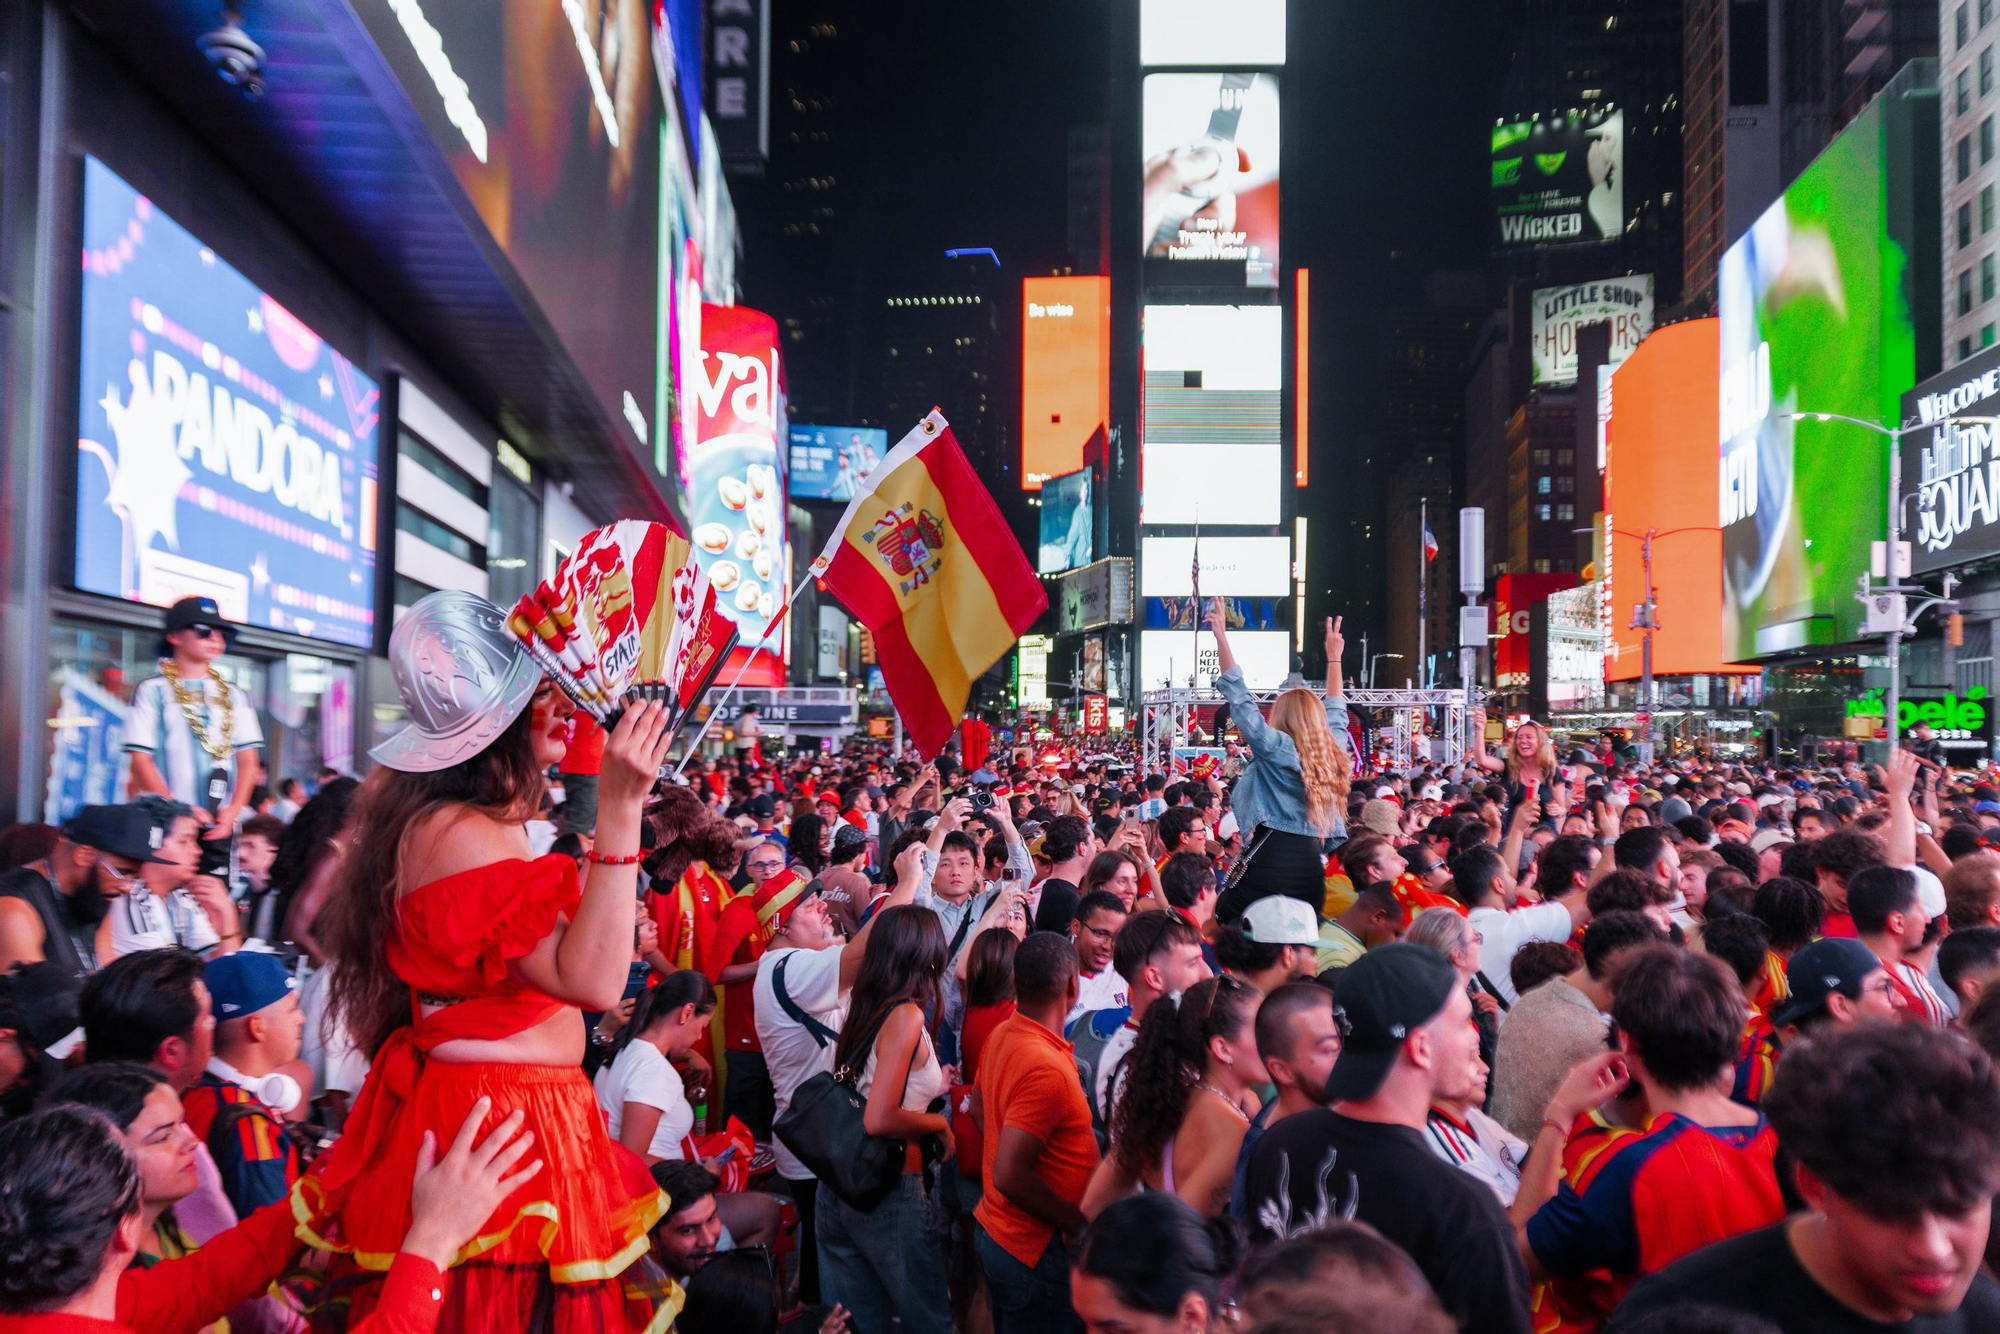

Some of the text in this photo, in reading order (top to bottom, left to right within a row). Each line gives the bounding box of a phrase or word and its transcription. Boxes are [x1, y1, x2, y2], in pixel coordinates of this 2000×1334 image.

[1545, 285, 1643, 320] LITTLE SHOP
[1545, 313, 1642, 369] HORS
[1918, 369, 1999, 426] WELCOME
[153, 350, 345, 528] PANDORA
[1090, 698, 1104, 727] tkts
[1898, 686, 1986, 737] pelé
[1908, 729, 1972, 740] SCCER
